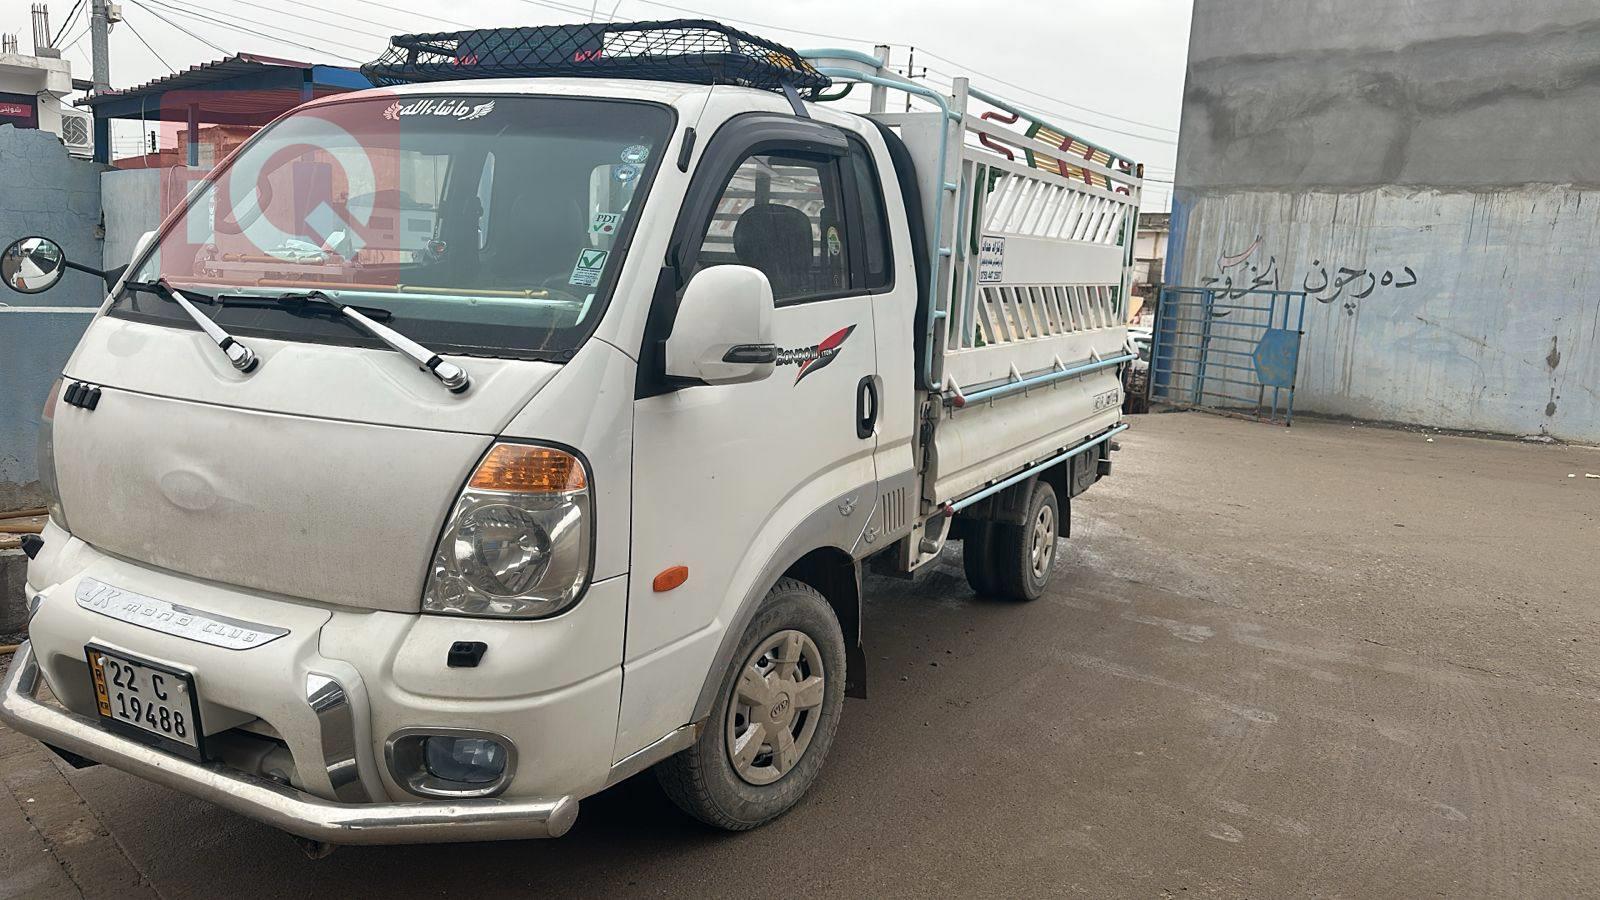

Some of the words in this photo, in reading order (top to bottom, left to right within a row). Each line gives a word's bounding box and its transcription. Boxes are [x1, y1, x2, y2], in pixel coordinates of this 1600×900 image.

[596, 214, 617, 223] PDI
[110, 661, 139, 693] 22
[152, 674, 168, 701] C
[116, 692, 186, 738] 19488
